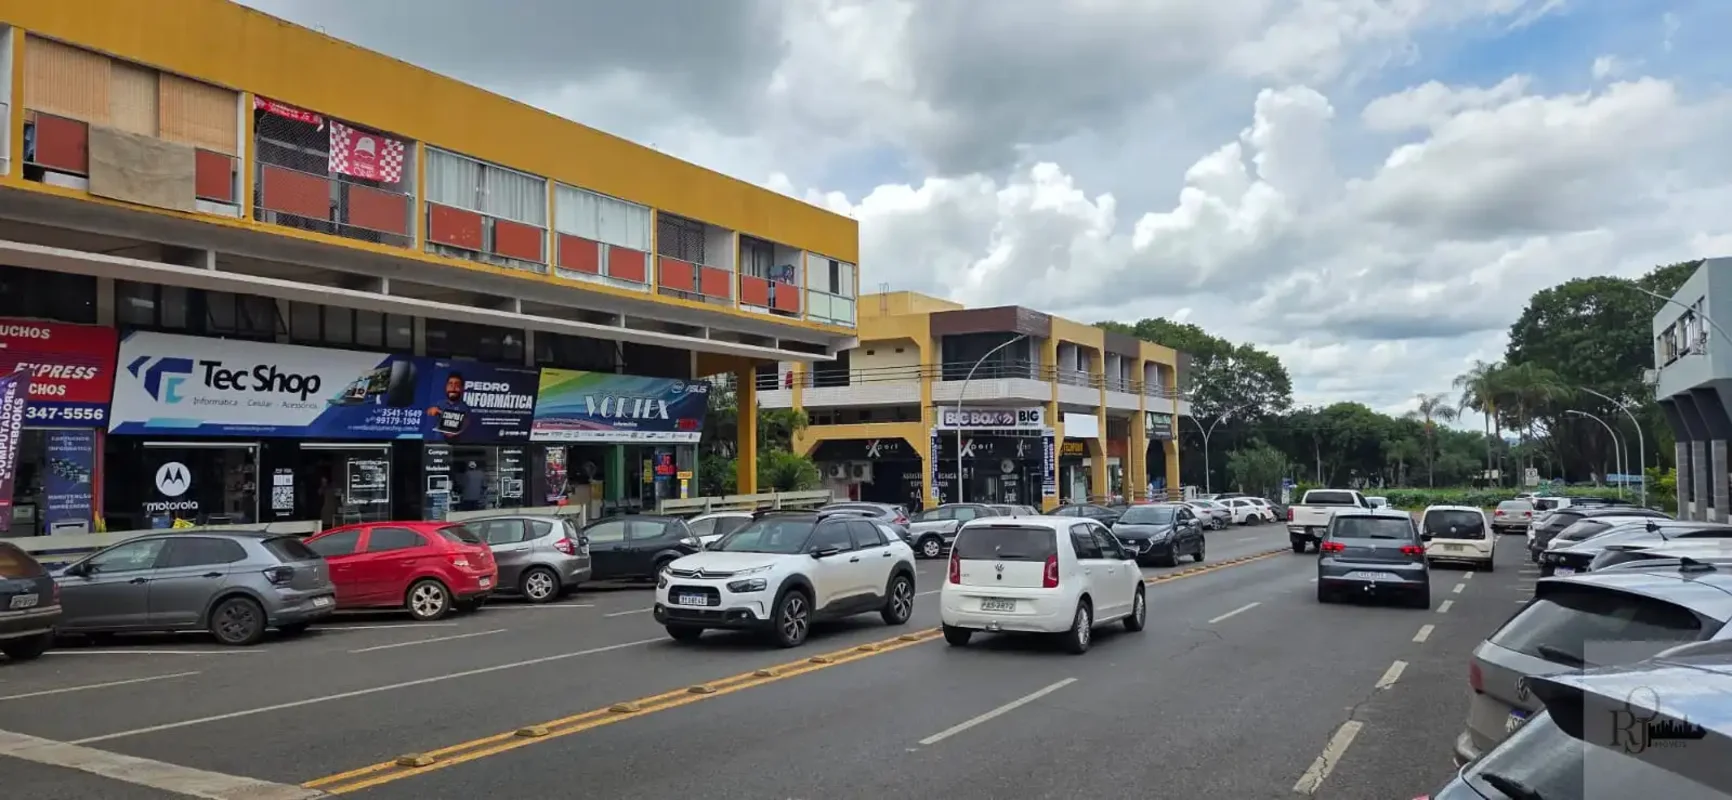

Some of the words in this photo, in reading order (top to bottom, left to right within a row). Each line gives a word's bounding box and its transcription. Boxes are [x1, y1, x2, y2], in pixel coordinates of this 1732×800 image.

[199, 360, 249, 391] Tec
[252, 364, 321, 401] Shop
[464, 380, 511, 392] PEDRO
[463, 392, 533, 410] INFORMÁTICA
[584, 393, 670, 420] VORTEX
[1018, 410, 1039, 422] BIG
[146, 500, 199, 512] motorola
